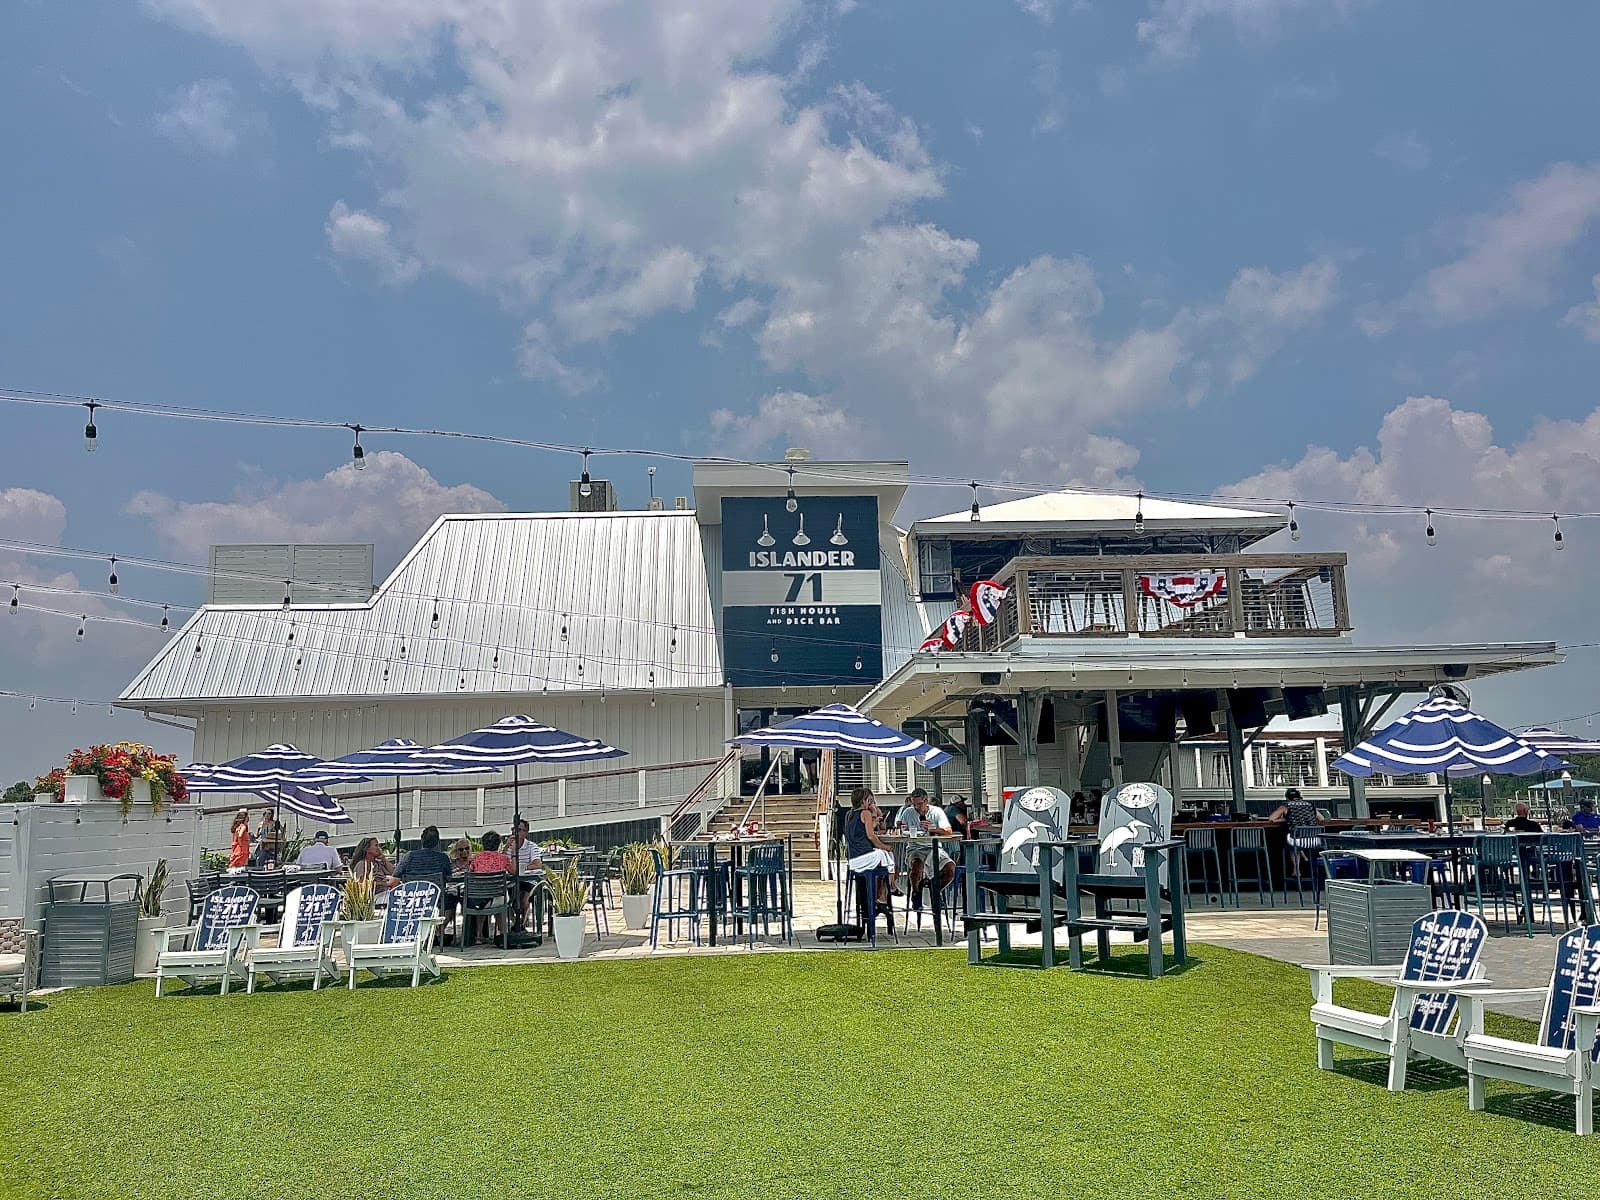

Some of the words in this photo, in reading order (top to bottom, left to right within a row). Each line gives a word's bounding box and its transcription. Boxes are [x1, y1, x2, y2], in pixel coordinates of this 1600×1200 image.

[749, 551, 855, 567] ISLANDER
[783, 573, 822, 602] 71
[770, 607, 795, 615] FISH
[800, 607, 837, 615] HOUSE
[786, 617, 814, 625] DECK
[819, 617, 841, 625] BAR
[301, 893, 336, 902] LANDER
[394, 888, 436, 897] ISLANDER
[210, 895, 255, 904] ISLANDER
[405, 897, 422, 908] 71
[221, 903, 239, 915] 71
[304, 901, 321, 913] 71
[1420, 920, 1480, 939] ISLANDER
[1436, 936, 1460, 956] 71
